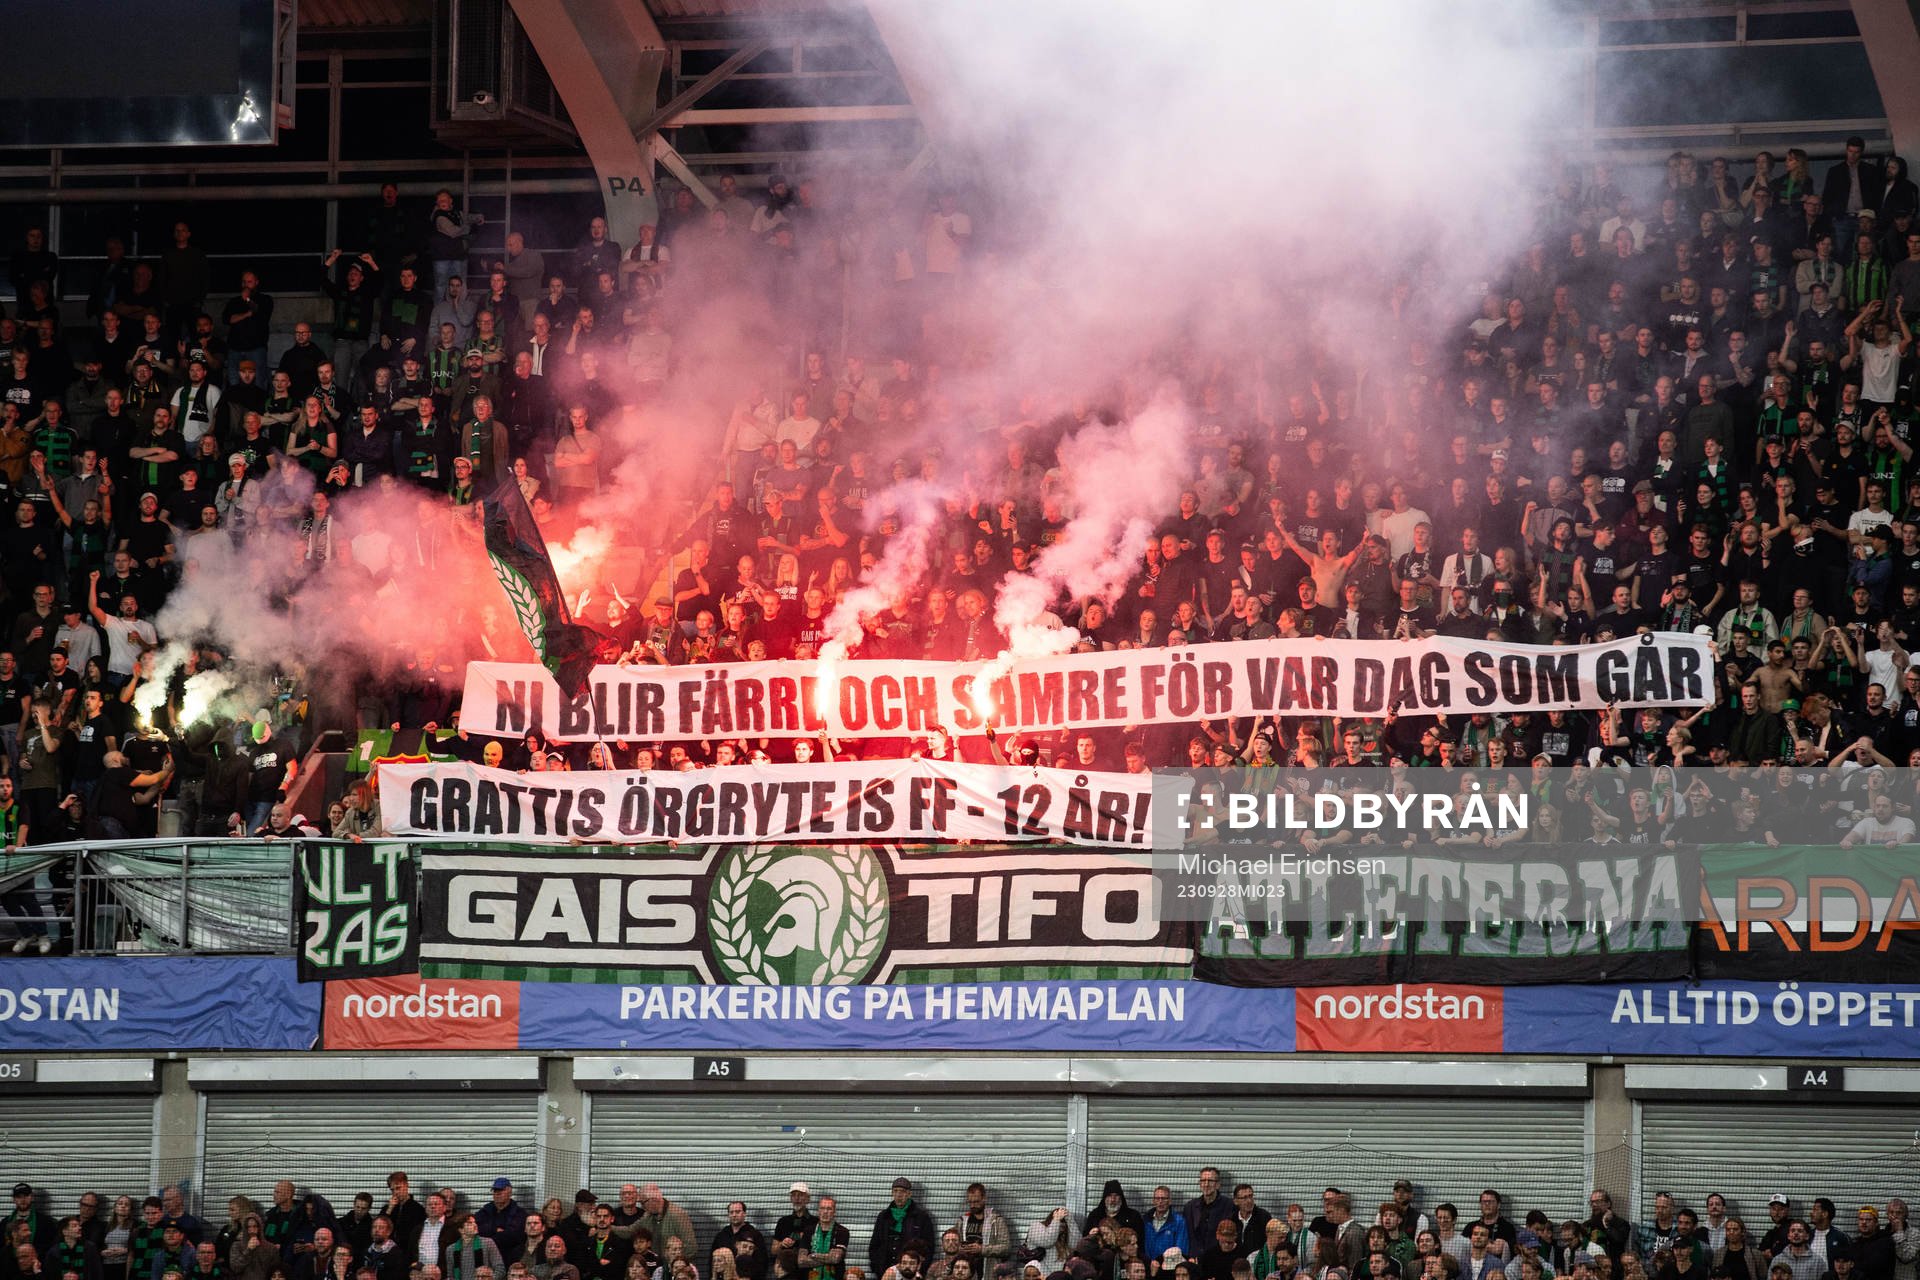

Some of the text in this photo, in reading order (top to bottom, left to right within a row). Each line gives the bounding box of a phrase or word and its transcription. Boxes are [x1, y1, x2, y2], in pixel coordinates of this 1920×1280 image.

[608, 176, 646, 197] P4
[496, 680, 544, 732] NI
[559, 682, 665, 736] BLIR
[839, 675, 940, 732] OCH
[1141, 653, 1233, 718] FÖR
[1247, 657, 1339, 710] VAR
[1353, 651, 1451, 711] DAG
[1464, 651, 1579, 706] SOM
[1597, 632, 1703, 704] GÅR
[410, 777, 605, 837] GRATTIS
[619, 775, 836, 836] ÖRGRYTE
[847, 776, 899, 833] IS
[909, 775, 963, 830] FF
[998, 783, 1055, 836] 12
[1063, 774, 1152, 843] ÅR!
[447, 873, 697, 945] GAIS
[907, 872, 1164, 942] TIFO
[342, 983, 502, 1019] nordstan
[620, 985, 851, 1020] PARKERING
[925, 986, 1185, 1022] HEMMAPLAN
[1314, 984, 1485, 1021] nordstan
[1611, 982, 1920, 1028] ALLTID ÖPPET
[707, 1060, 730, 1076] A5
[1803, 1070, 1829, 1086] A4
